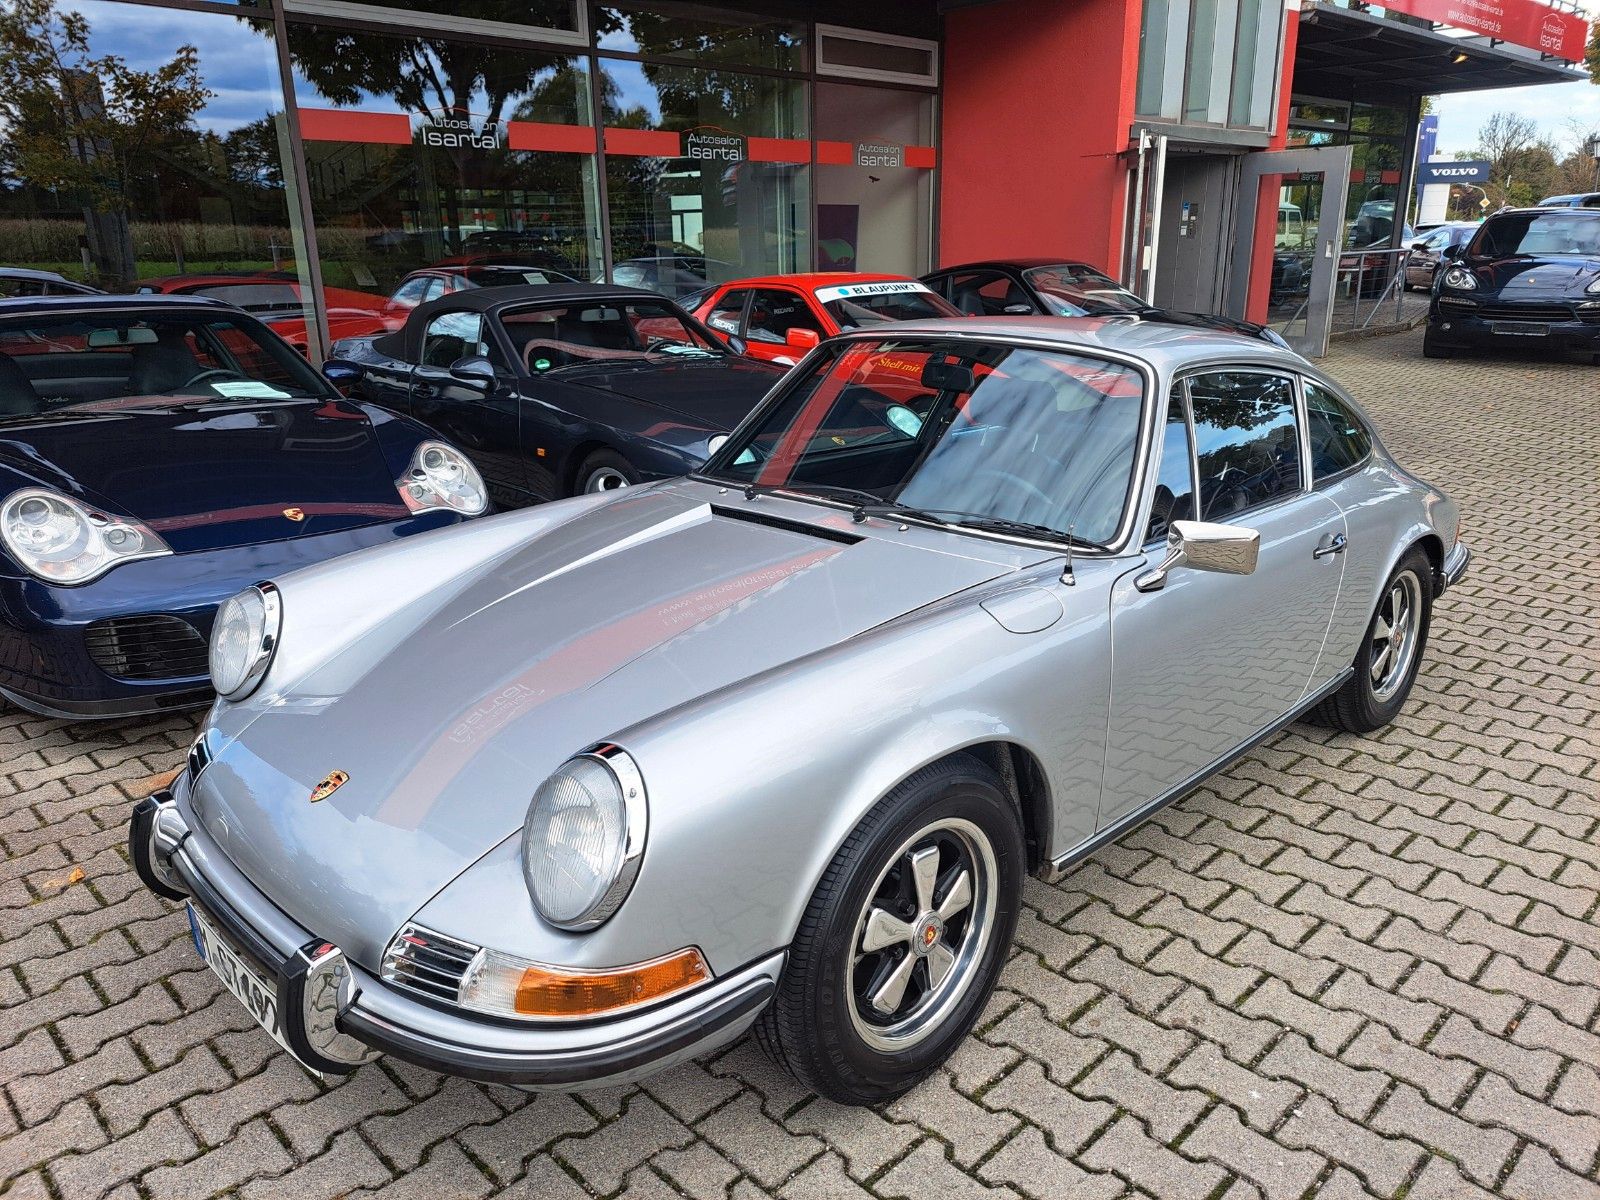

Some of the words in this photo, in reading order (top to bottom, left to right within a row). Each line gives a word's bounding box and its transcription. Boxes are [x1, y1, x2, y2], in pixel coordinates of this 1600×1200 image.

[1542, 20, 1565, 35] Autosalon
[1540, 31, 1564, 50] Isartal
[421, 116, 498, 131] Autosalon
[422, 127, 500, 149] Isartal
[687, 132, 742, 146] Autosalon
[687, 143, 743, 161] Isartal
[858, 143, 901, 154] Autosalon
[857, 152, 901, 167] Isartal
[1430, 167, 1479, 176] VOLVO
[852, 283, 918, 295] BLAUPUNKT
[712, 318, 735, 331] RECARO
[878, 357, 903, 371] Shell
[902, 363, 921, 373] mit
